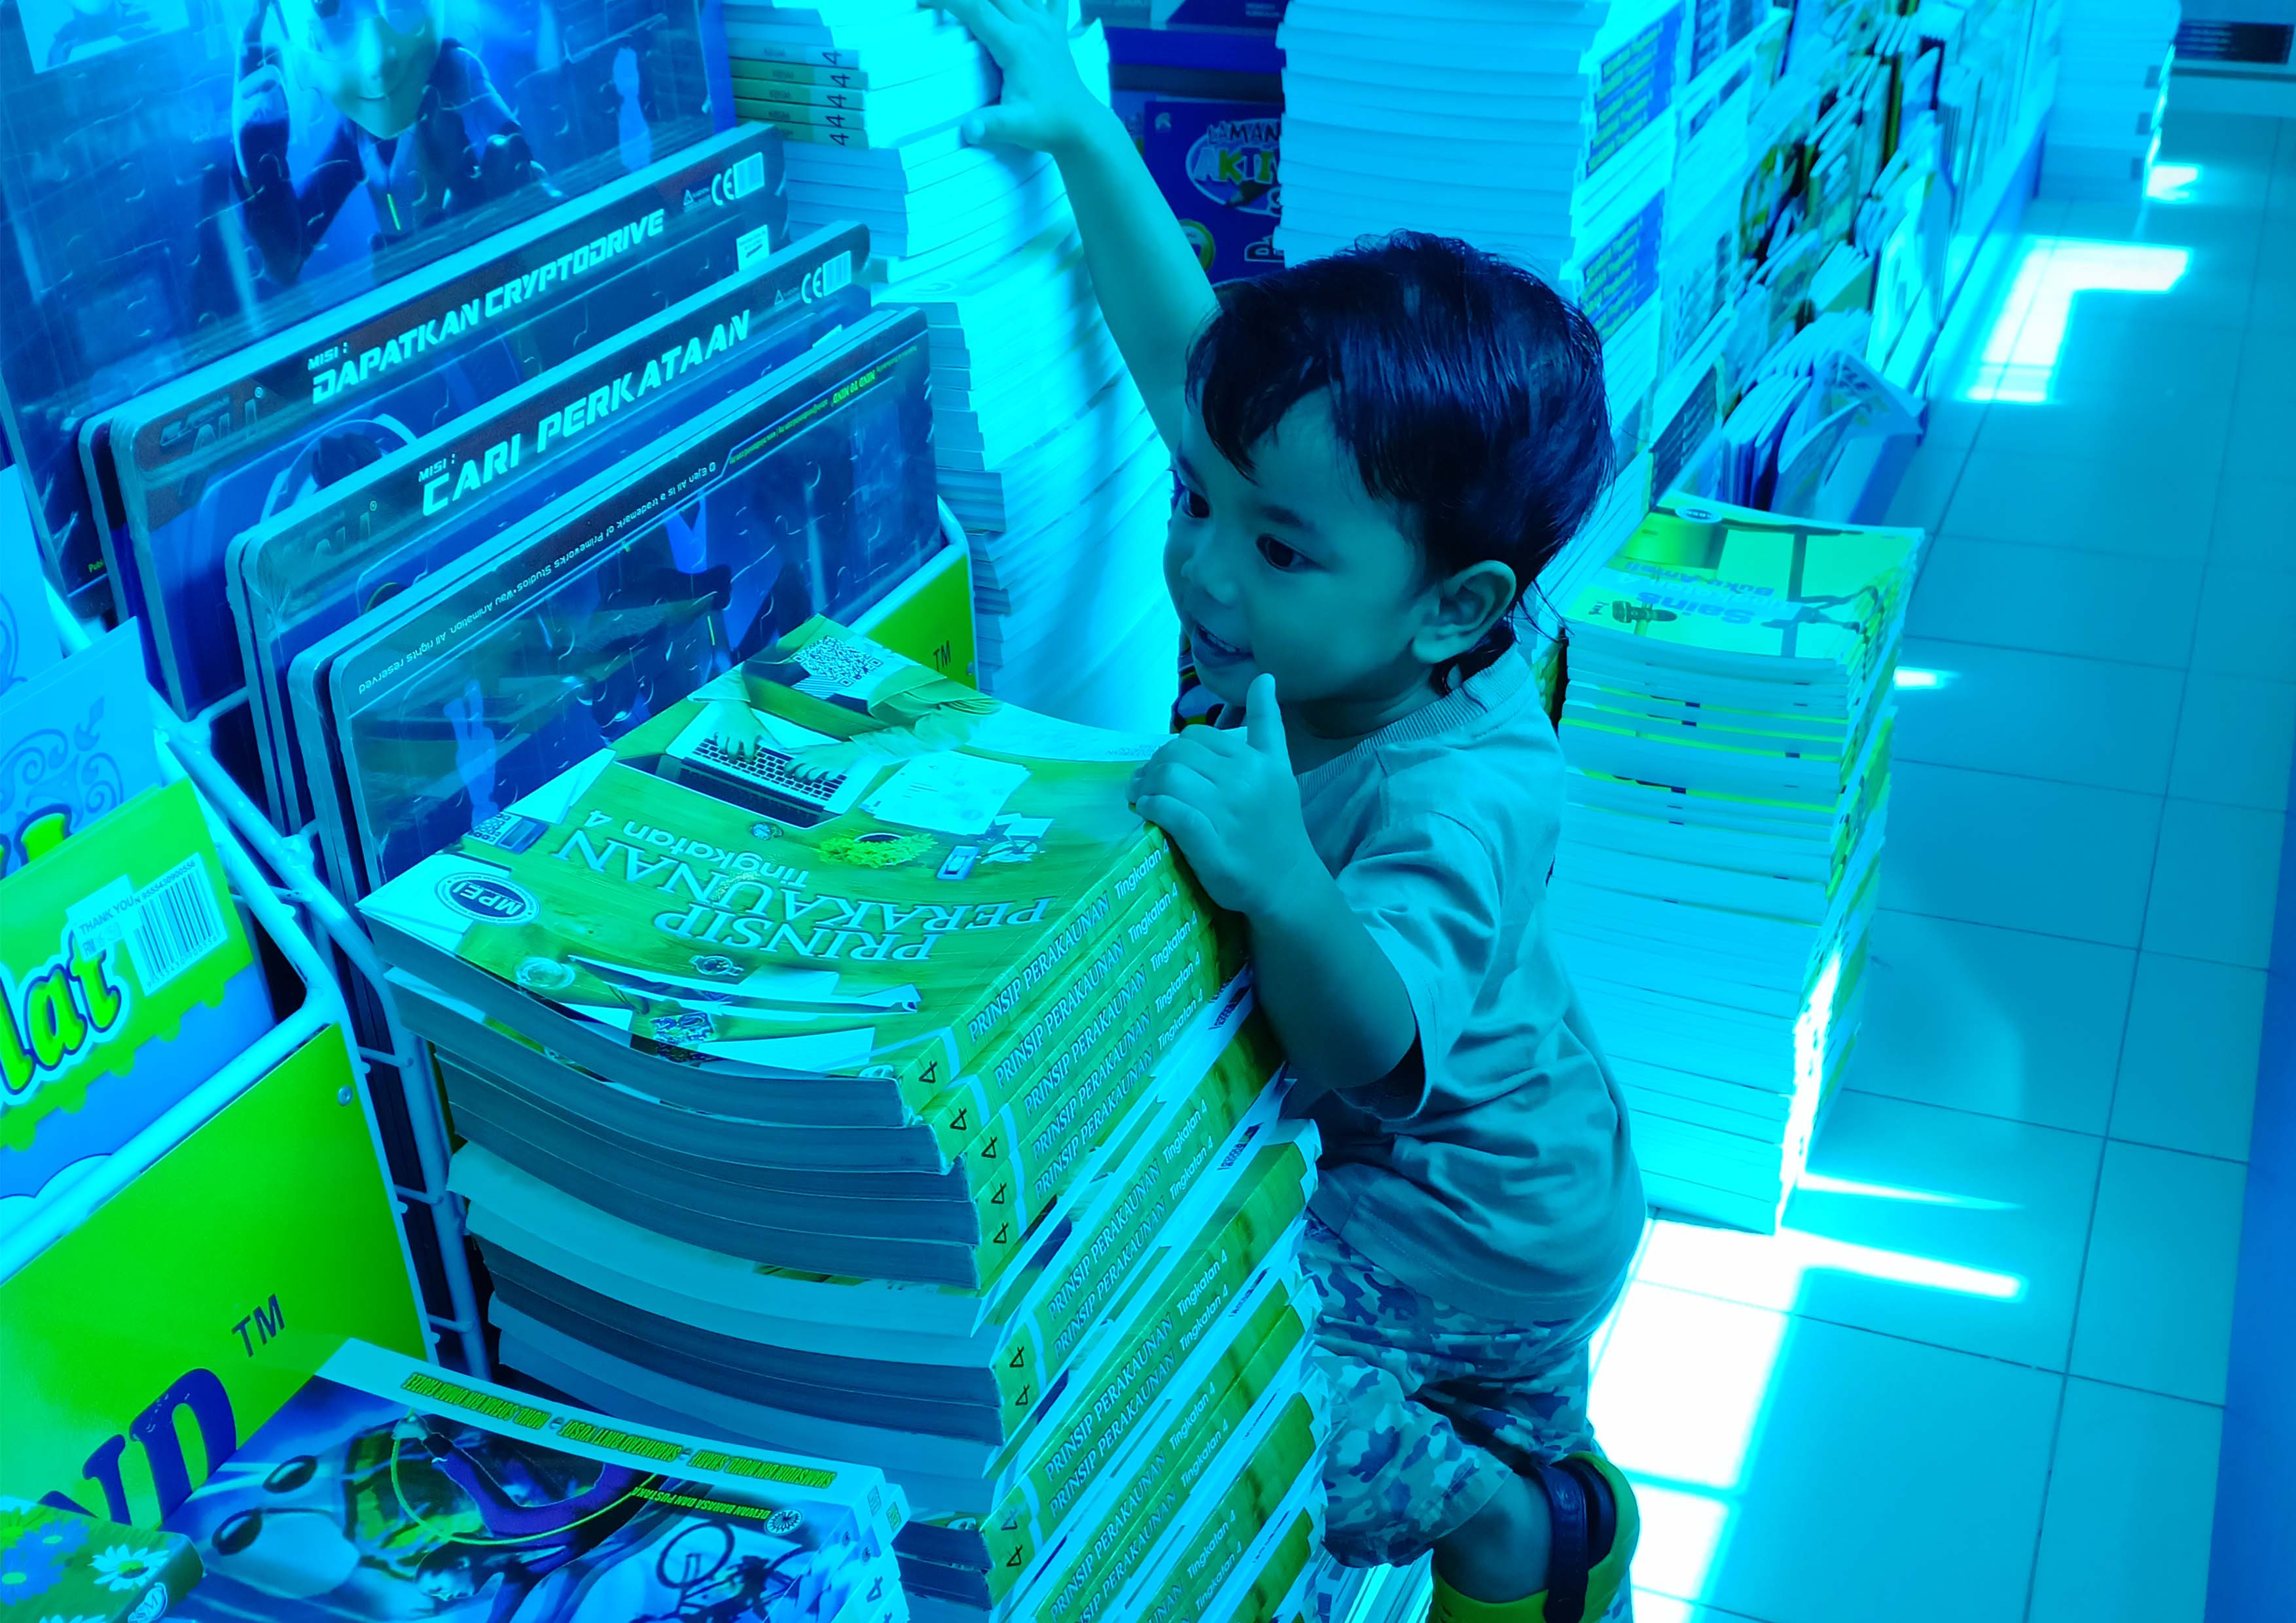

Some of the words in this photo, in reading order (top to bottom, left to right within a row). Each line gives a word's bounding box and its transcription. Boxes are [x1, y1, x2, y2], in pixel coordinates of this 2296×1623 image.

[822, 50, 842, 65] 4
[831, 73, 850, 88] 4
[825, 115, 845, 128] 4
[827, 94, 846, 108] 4
[830, 133, 849, 146] 4
[313, 298, 480, 405] DAPATKAN
[484, 208, 664, 318] CRYPTODRIVE
[423, 433, 521, 516] CARI
[537, 309, 749, 453] PERKATAAN
[418, 458, 447, 482] MISI
[1637, 592, 1755, 624] Sains
[355, 655, 406, 697] reserved
[932, 641, 952, 673] TM
[583, 810, 613, 828] 4
[553, 830, 1057, 931] PERAKAUNAN
[623, 821, 809, 889] Tingkatan
[79, 908, 114, 932] THANK
[112, 895, 136, 914] YOU
[453, 882, 522, 915] MPEI
[655, 902, 944, 960] PRINSIP
[967, 978, 1021, 1042] PRINSIP
[1023, 890, 1110, 990] PERAKAUNAN
[1114, 849, 1161, 900] Tingkatan
[1163, 838, 1170, 853] 4
[994, 1024, 1043, 1089] PRINSIP
[1044, 935, 1125, 1037] PERAKAUNAN
[1128, 892, 1171, 944] Tingkatan
[1172, 882, 1178, 897] 4
[1024, 1051, 1070, 1115] PRINSIP
[1071, 964, 1147, 1063] PERAKAUNAN
[1150, 922, 1191, 971] Tingkatan
[1192, 910, 1198, 925] 4
[1032, 1097, 1078, 1161] PRINSIP
[1079, 1006, 1151, 1105] PERAKAUNAN
[1155, 963, 1194, 1013] Tingkatan
[1195, 952, 1200, 966] 4
[1033, 1137, 1079, 1200] PRINSIP
[1080, 1044, 1154, 1145] PERAKAUNAN
[1158, 1000, 1196, 1050] Tingkatan
[1198, 988, 1203, 1003] 4
[1049, 1257, 1090, 1321] PRINSIP
[1090, 1158, 1161, 1262] PERAKAUNAN
[1162, 1111, 1202, 1164] Tingkatan
[1201, 1099, 1208, 1115] 4
[1053, 1293, 1095, 1359] PRINSIP
[1096, 1194, 1167, 1301] PERAKAUNAN
[1168, 1147, 1208, 1200] Tingkatan
[1208, 1135, 1213, 1150] 4
[231, 1293, 286, 1357] TM
[1044, 1416, 1093, 1482] PRINSIP
[1093, 1313, 1174, 1423] PERAKAUNAN
[1177, 1260, 1220, 1317] Tingkatan
[1221, 1249, 1227, 1263] 4
[1049, 1451, 1098, 1518] PRINSIP
[1098, 1350, 1176, 1457] PERAKAUNAN
[1179, 1295, 1221, 1351] Tingkatan
[1223, 1283, 1229, 1298] 4
[631, 1486, 677, 1503] PUSTAKA
[674, 1495, 698, 1508] DAN
[695, 1499, 736, 1514] BAHASA
[732, 1506, 771, 1520] DEWAN
[1049, 1556, 1094, 1622] PRINSIP
[1094, 1448, 1167, 1560] PERAKAUNAN
[1169, 1392, 1210, 1451] Tingkatan
[1210, 1381, 1215, 1395] 4
[1103, 1487, 1177, 1599] PERAKAUNAN
[1181, 1431, 1221, 1488] Tingkatan
[1223, 1418, 1229, 1432] 4
[1187, 1522, 1229, 1578] Tingkatan
[1230, 1509, 1236, 1522] 4
[1196, 1553, 1234, 1611] Tingkatan
